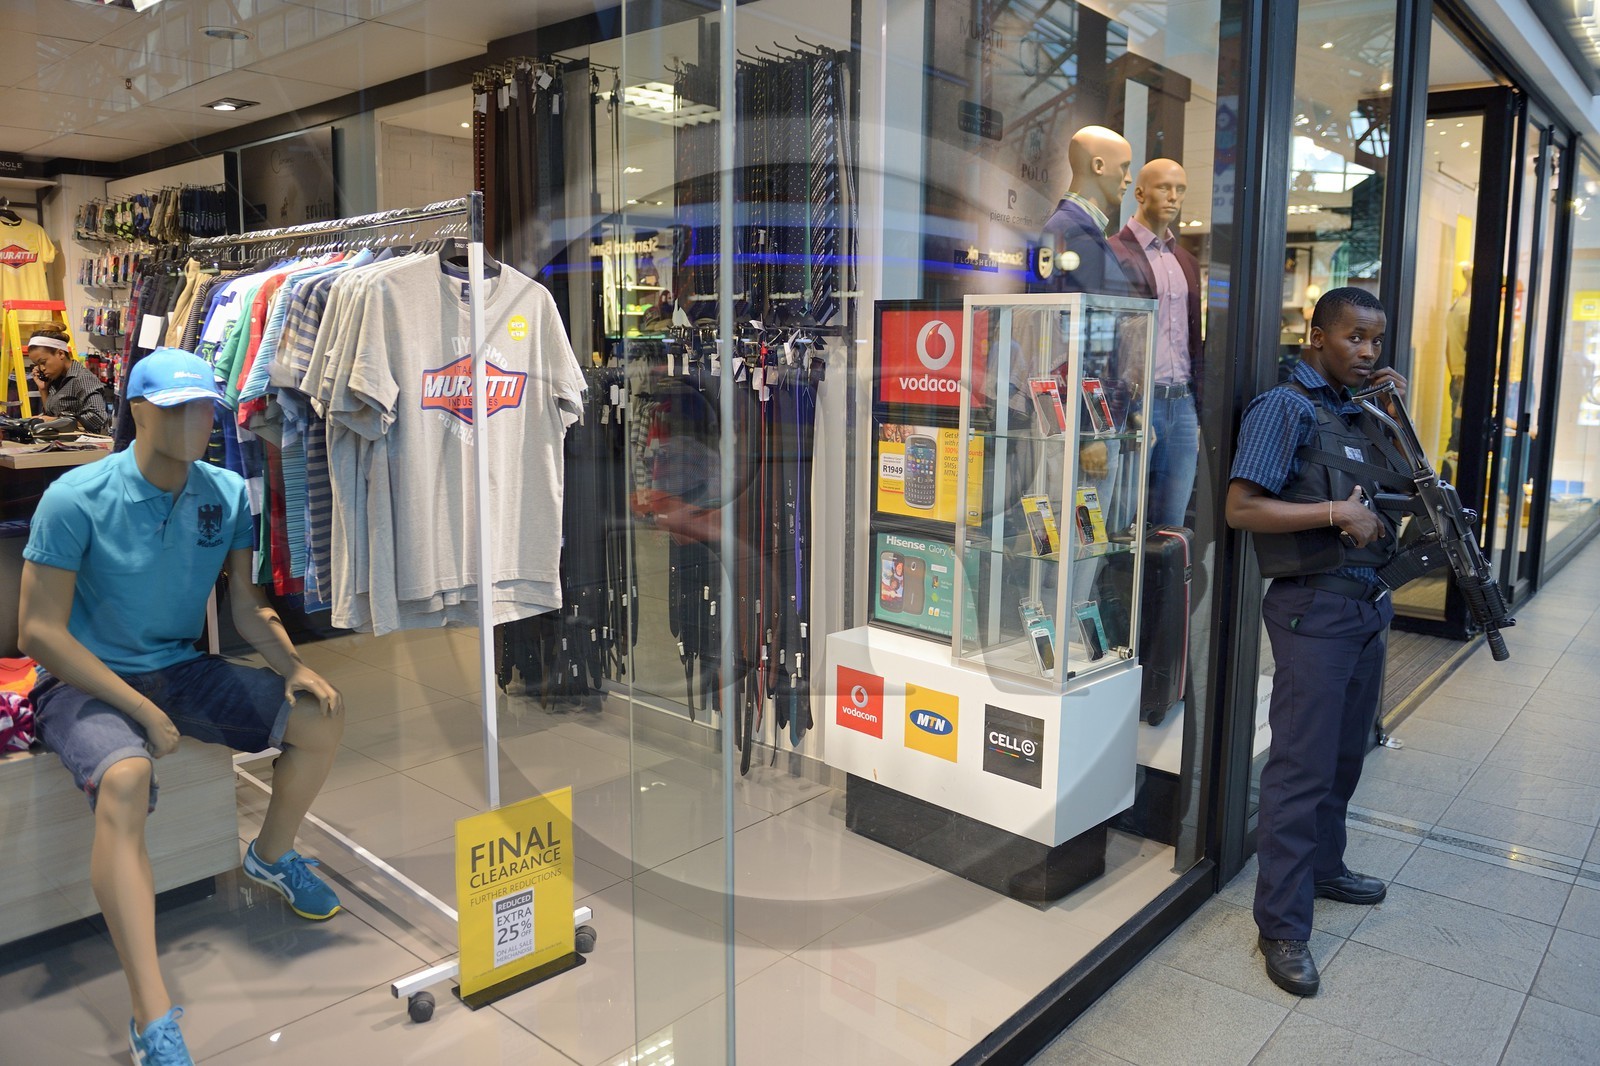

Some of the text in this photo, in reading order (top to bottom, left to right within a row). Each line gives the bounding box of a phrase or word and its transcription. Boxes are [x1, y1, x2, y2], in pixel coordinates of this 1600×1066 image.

[1021, 163, 1048, 184] POLO
[990, 211, 1011, 223] pierre
[451, 336, 508, 370] DYAMO
[424, 374, 519, 398] MURTTI
[448, 398, 498, 407] INDUSES
[882, 464, 904, 475] R1949
[886, 535, 947, 557] Hisense Glory
[842, 706, 877, 723] vodacom
[916, 713, 946, 732] MTN
[471, 821, 561, 873] FINAL
[470, 847, 561, 889] CLEARANCE
[470, 868, 562, 907] FURTHER REDUCTIONS
[497, 894, 531, 912] REDUCED
[497, 906, 532, 927] EXTRA
[520, 929, 532, 938] OFF
[496, 938, 532, 957] ON ALL SALE
[496, 946, 532, 963] MERCHANDISE
